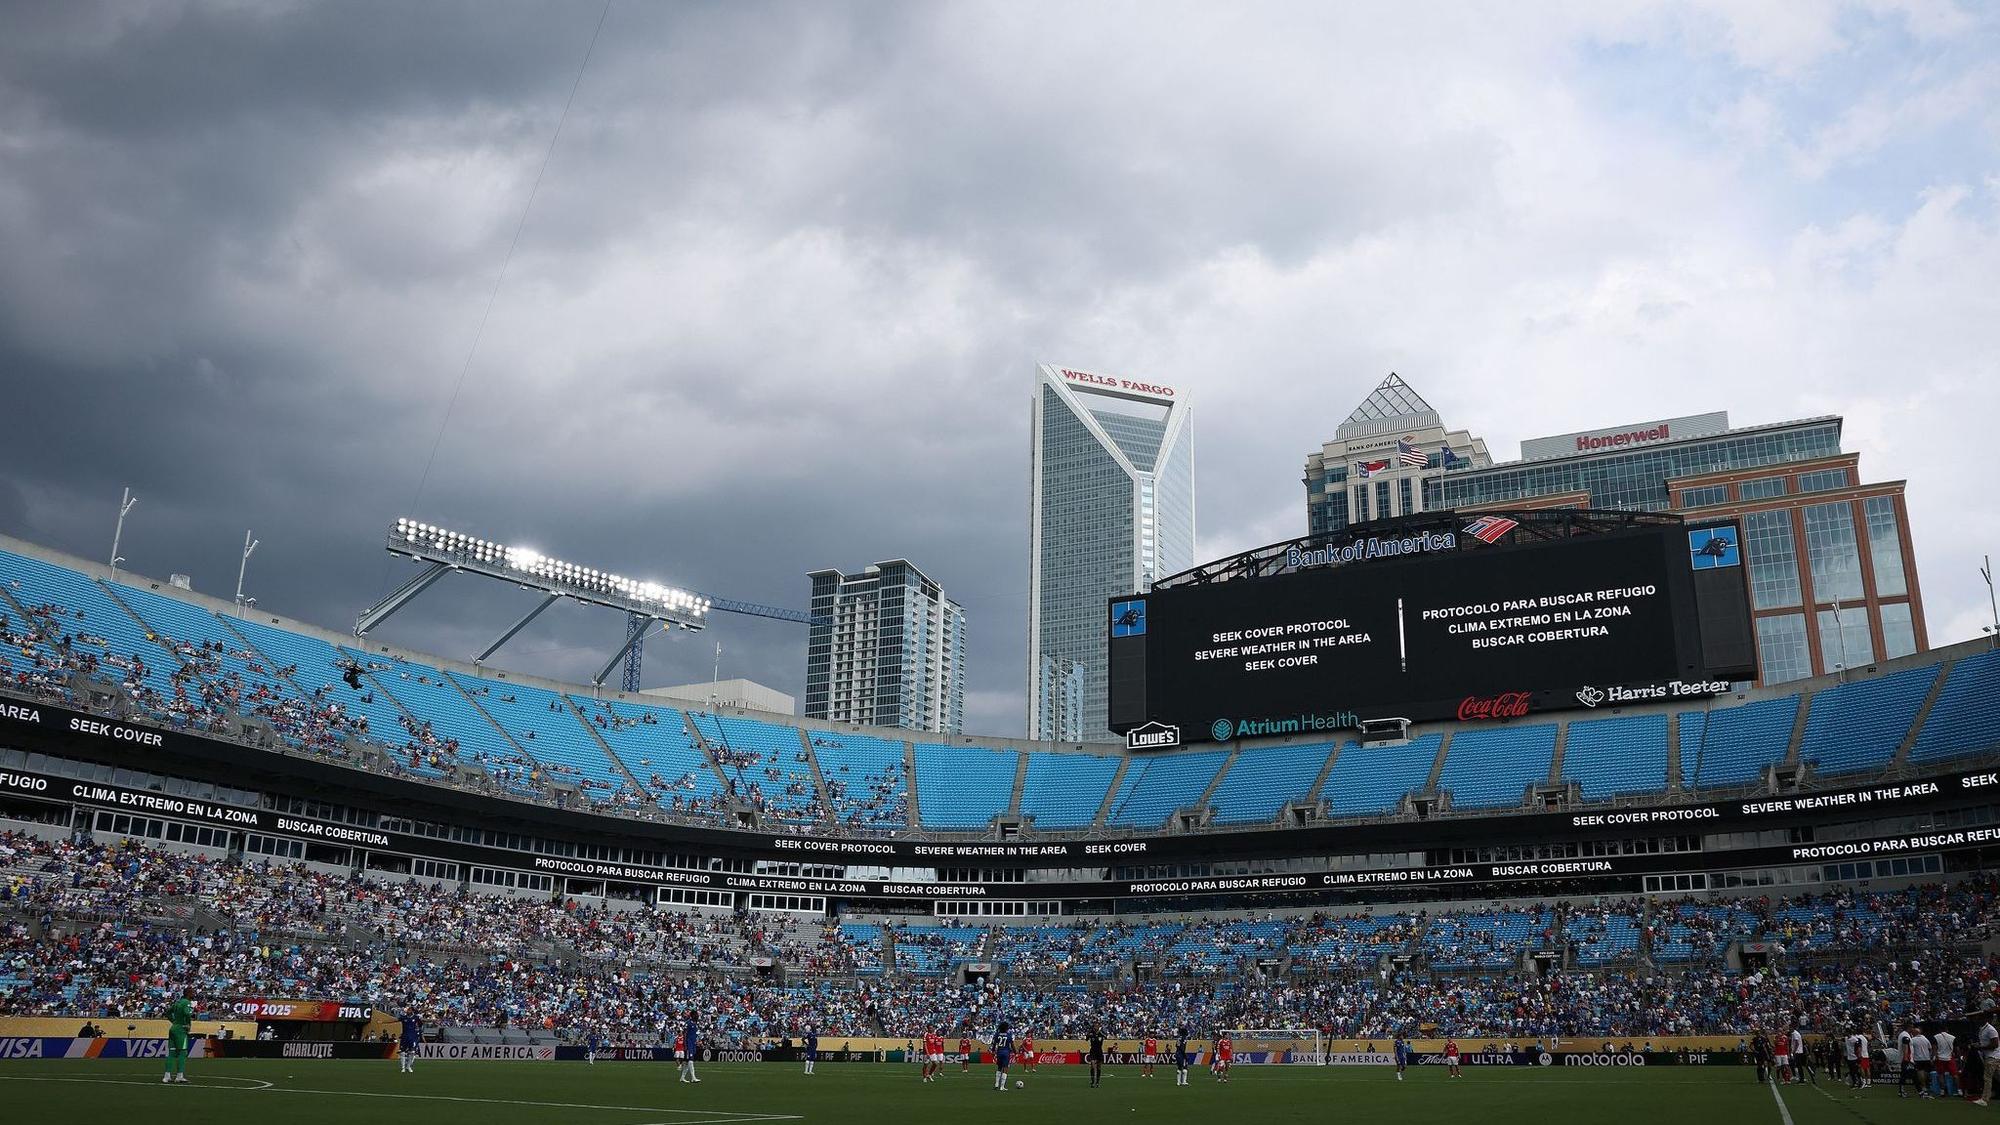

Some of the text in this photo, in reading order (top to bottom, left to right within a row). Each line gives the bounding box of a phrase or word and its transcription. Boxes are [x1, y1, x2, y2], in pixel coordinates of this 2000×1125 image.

[1061, 369, 1174, 396] WELLS FARGO
[1576, 424, 1669, 450] Honeywell
[1287, 531, 1456, 568] Bank of America
[1423, 584, 1656, 620] PROTOCOLO PARA BUSCAR REFUGIO
[1449, 605, 1632, 634] CLIMA EXTREMO EN LA ZONA
[1213, 618, 1351, 643] SEEK COVER PROTOCOL
[1473, 625, 1609, 649] BUSCAR COBERTURA
[1195, 632, 1372, 661] SEVERE WEATHER IN THE AREA
[1246, 654, 1318, 672] SEEK COVER
[1608, 680, 1729, 702] Harris Teeter
[0, 703, 40, 723] AREA
[1236, 711, 1359, 736] Atrium Health
[70, 718, 163, 747] SEEK COVER
[1132, 730, 1175, 746] LOWE'S
[1962, 772, 1999, 788] SEEK
[73, 784, 258, 825] CLIMA EXTREMO EN LA ZONA
[1743, 782, 1939, 815] SEVERE WEATHER IN THE AREA
[1573, 807, 1720, 826] SEEK COVER PROTOCOL
[278, 818, 390, 847] BUSCAR COBERTURA
[775, 839, 896, 854] SEEK COVER PROTOCOL
[915, 846, 1068, 856] SEVERE WEATHER IN THE AREA
[1086, 842, 1147, 854] SEEK COVER
[1794, 828, 2000, 859] PROTOCOLO PARA BUSCAR REFU
[536, 857, 711, 884] PROTOCOLO PARA BUSCAR REFUGIO
[1324, 868, 1474, 885] CLIMA EXTREMO EN LA ZONA
[1493, 861, 1613, 876] BUSCAR COBERTURA
[727, 877, 866, 893] CLIMA EXTREMO EN LA ZONA
[883, 885, 986, 895] BUSCAR COBERTURA
[1131, 876, 1307, 893] PROTOCOLO PARA BUSCAR REFUGIO
[233, 1003, 259, 1015] CUP
[338, 1007, 361, 1018] FIFA
[282, 1043, 334, 1057] CHARLOTTE
[997, 1036, 1008, 1047] 27
[449, 1045, 468, 1058] OF
[471, 1046, 534, 1059] AMERICA
[624, 1049, 654, 1060] ULTRA
[718, 1051, 762, 1062] motorola
[1232, 1053, 1252, 1064] ISA
[1340, 1055, 1389, 1063] AMERICA
[1471, 1054, 1514, 1064] ULTRA
[1565, 1051, 1645, 1066] motorola
[1689, 1054, 1708, 1064] PIF
